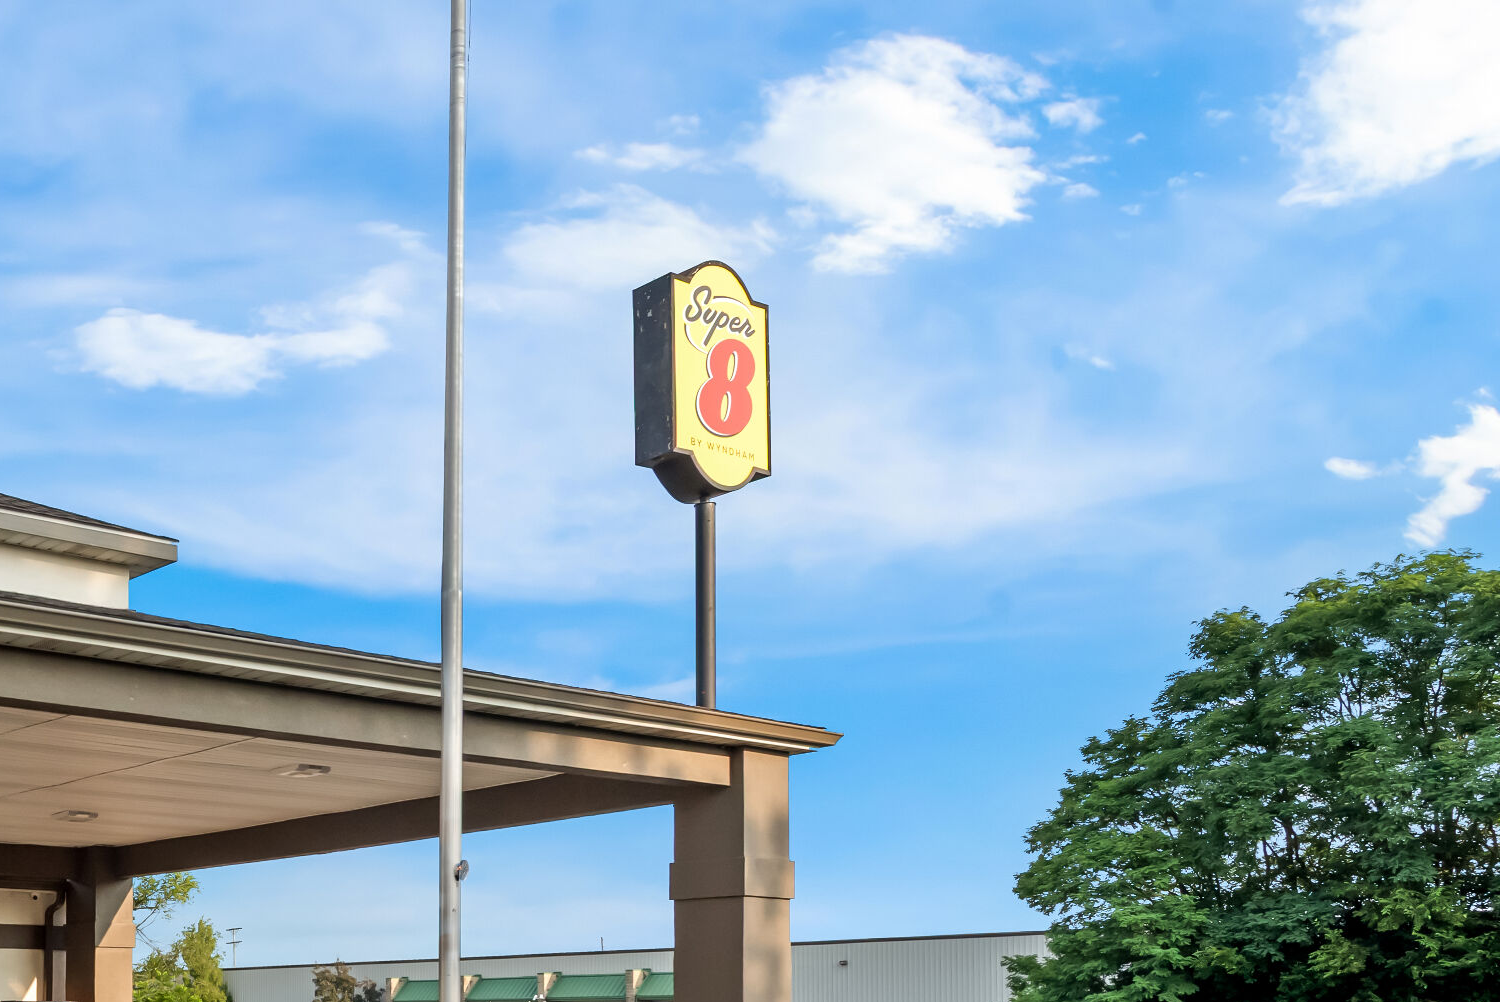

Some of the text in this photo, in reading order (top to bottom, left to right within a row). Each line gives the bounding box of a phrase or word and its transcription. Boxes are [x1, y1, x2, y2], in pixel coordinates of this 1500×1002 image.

[684, 285, 756, 347] Super
[695, 338, 756, 438] 8
[690, 437, 755, 462] BY WYNDHAM
